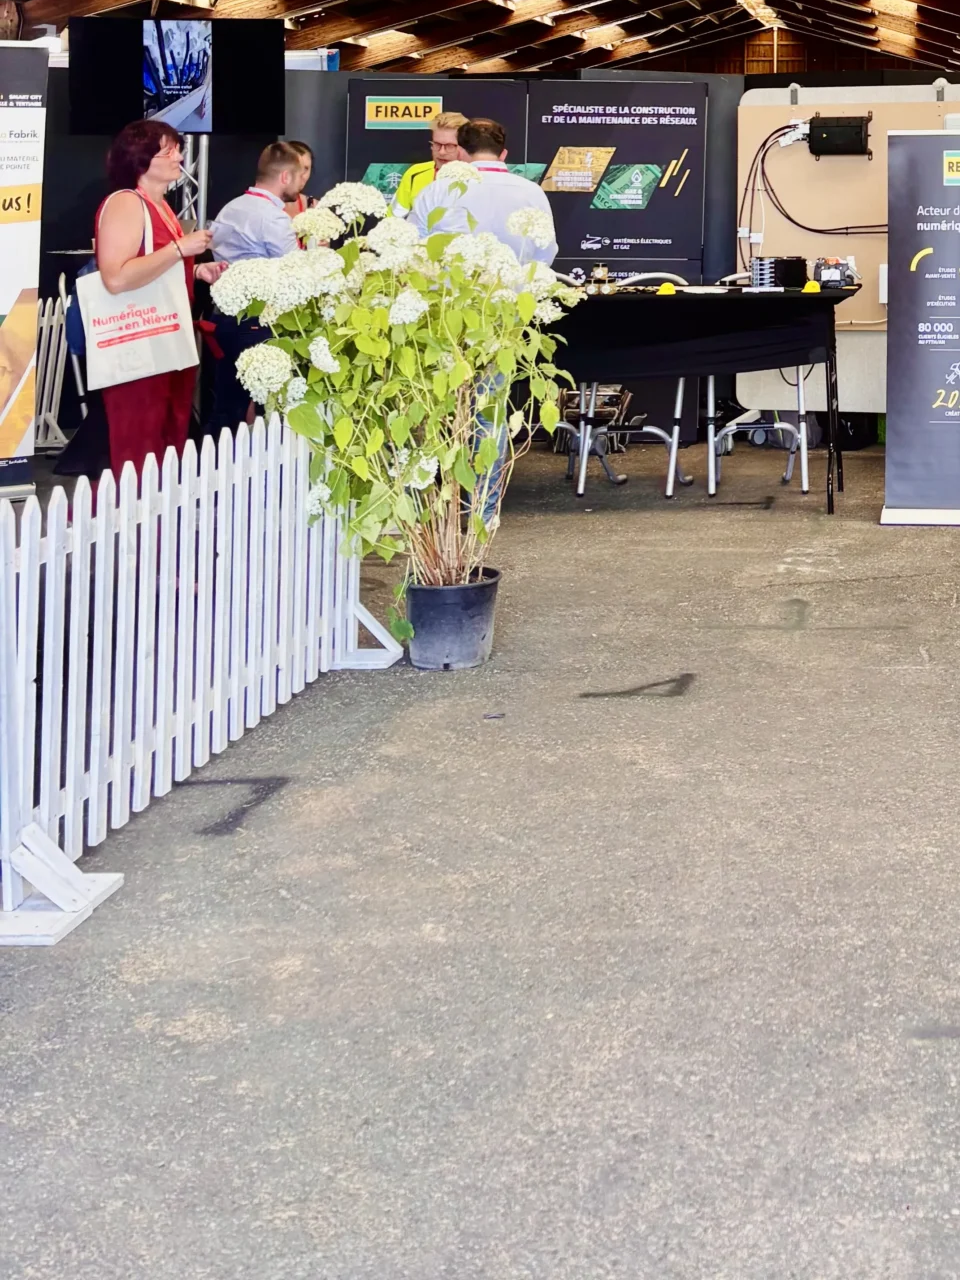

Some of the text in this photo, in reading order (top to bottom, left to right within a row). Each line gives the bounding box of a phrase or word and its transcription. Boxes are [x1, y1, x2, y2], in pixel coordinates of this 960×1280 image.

[375, 106, 433, 118] FIRALP
[553, 104, 695, 115] SPÉCIALISTE DE LA CONSTRUCTION
[567, 116, 577, 124] LA
[659, 115, 697, 125] RÉSEAUX
[9, 130, 38, 138] Fabrik
[917, 205, 951, 216] Acteur
[92, 306, 157, 327] Numérique
[124, 312, 178, 330] en Nièvre
[918, 323, 953, 332] 80 000
